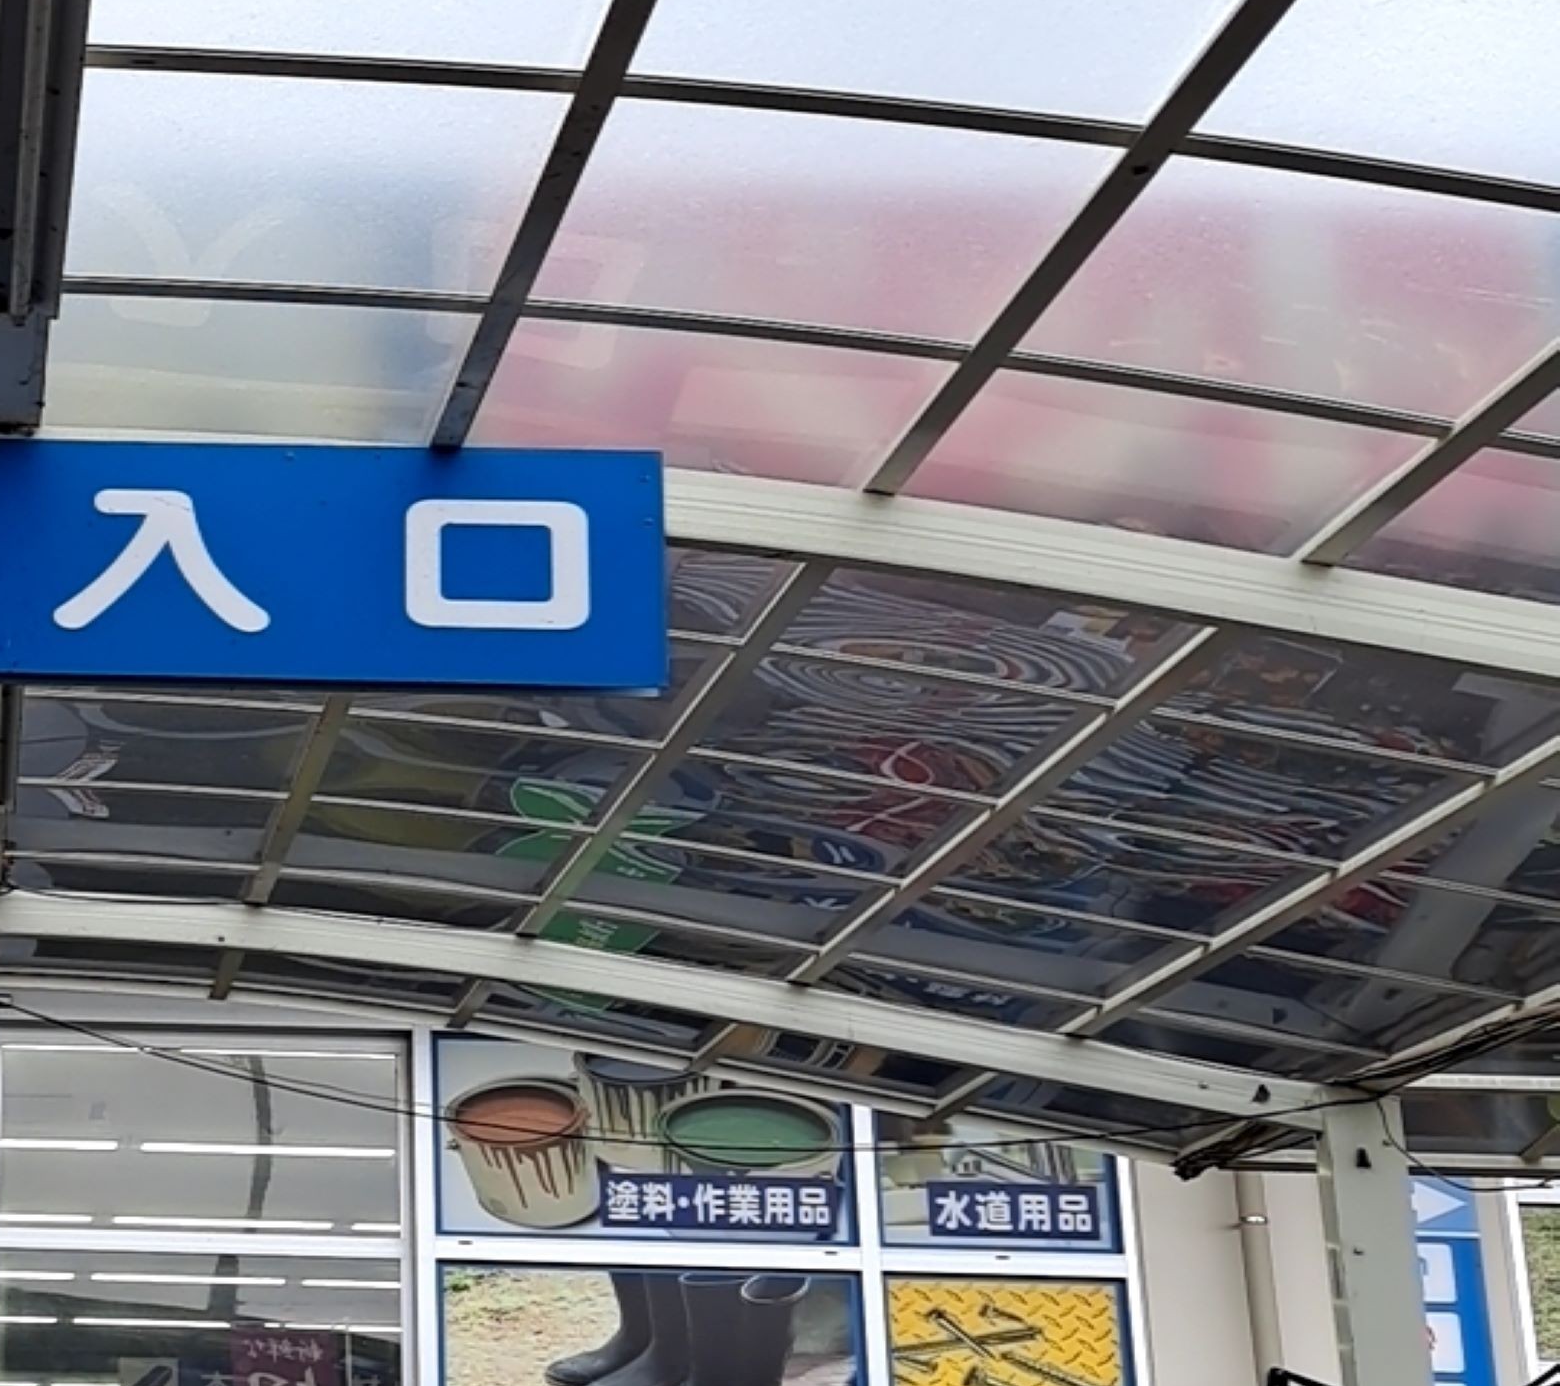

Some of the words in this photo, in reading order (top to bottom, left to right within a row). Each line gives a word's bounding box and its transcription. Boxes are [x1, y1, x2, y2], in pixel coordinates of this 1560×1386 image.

[607, 1181, 831, 1226] 塗料・作業用品
[935, 1191, 1093, 1233] 水道用品
